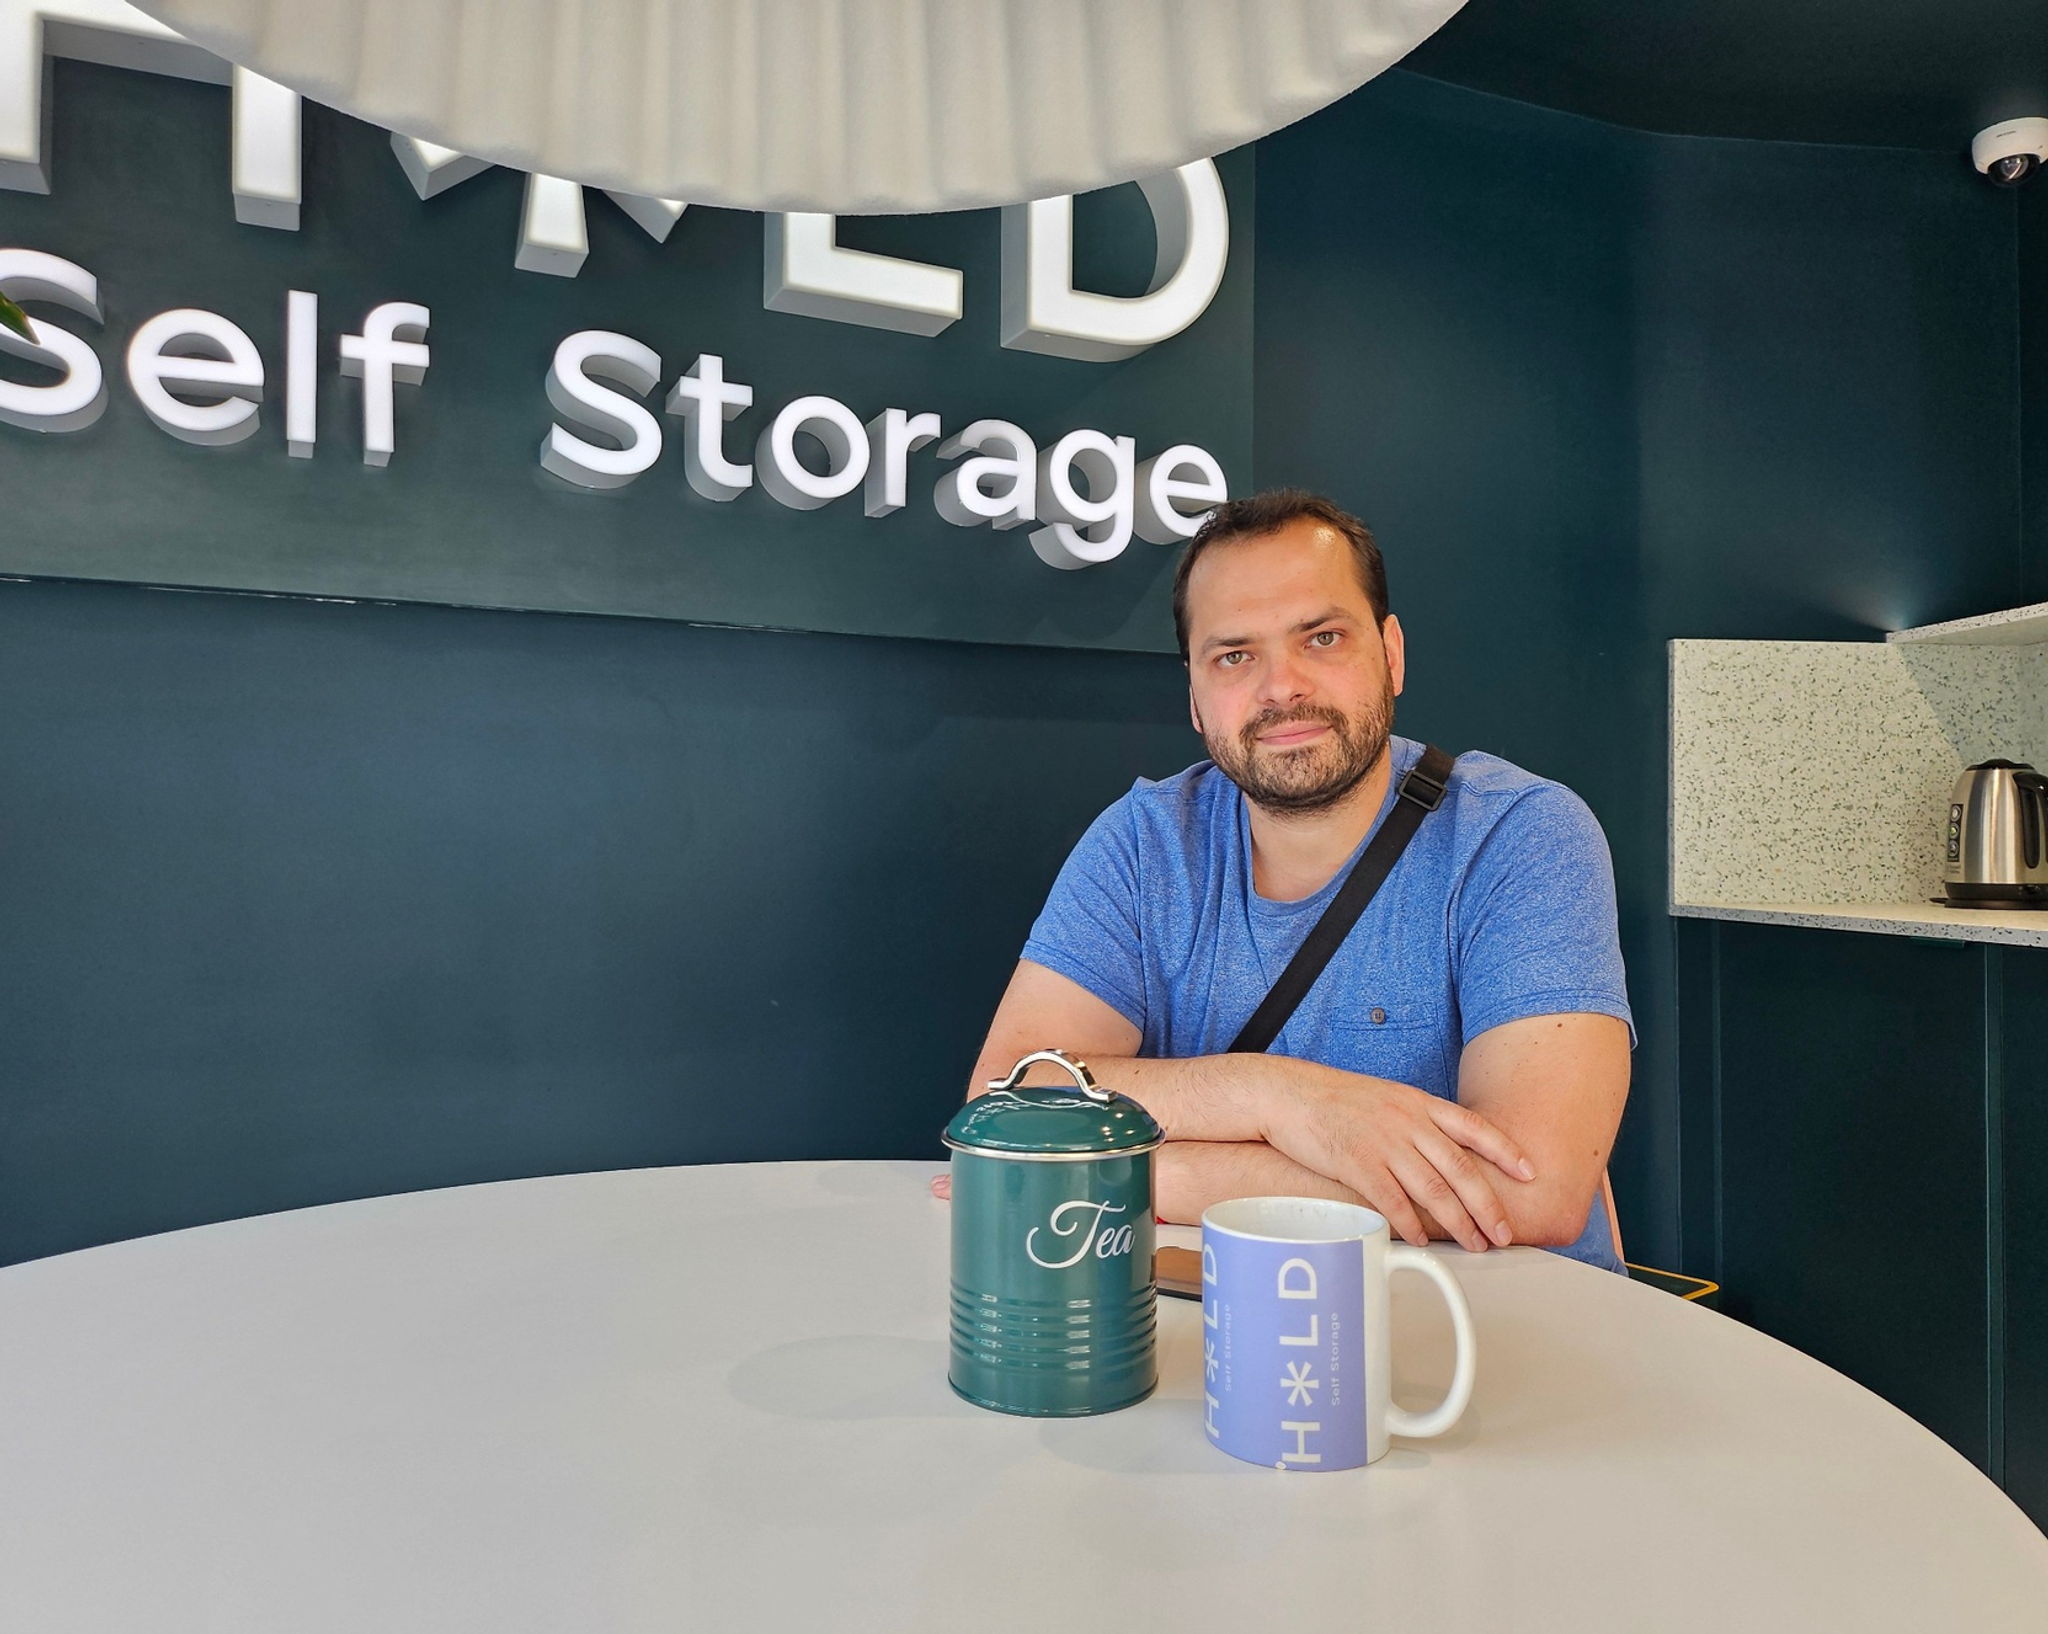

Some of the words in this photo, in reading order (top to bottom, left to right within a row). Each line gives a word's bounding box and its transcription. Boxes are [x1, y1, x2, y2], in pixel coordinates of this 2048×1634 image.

[0, 248, 431, 467] Self
[540, 329, 1230, 570] Storage
[1026, 1200, 1136, 1268] Tea
[1224, 1304, 1232, 1360] Storage
[1331, 1312, 1340, 1371] Storage
[1331, 1377, 1340, 1406] Self
